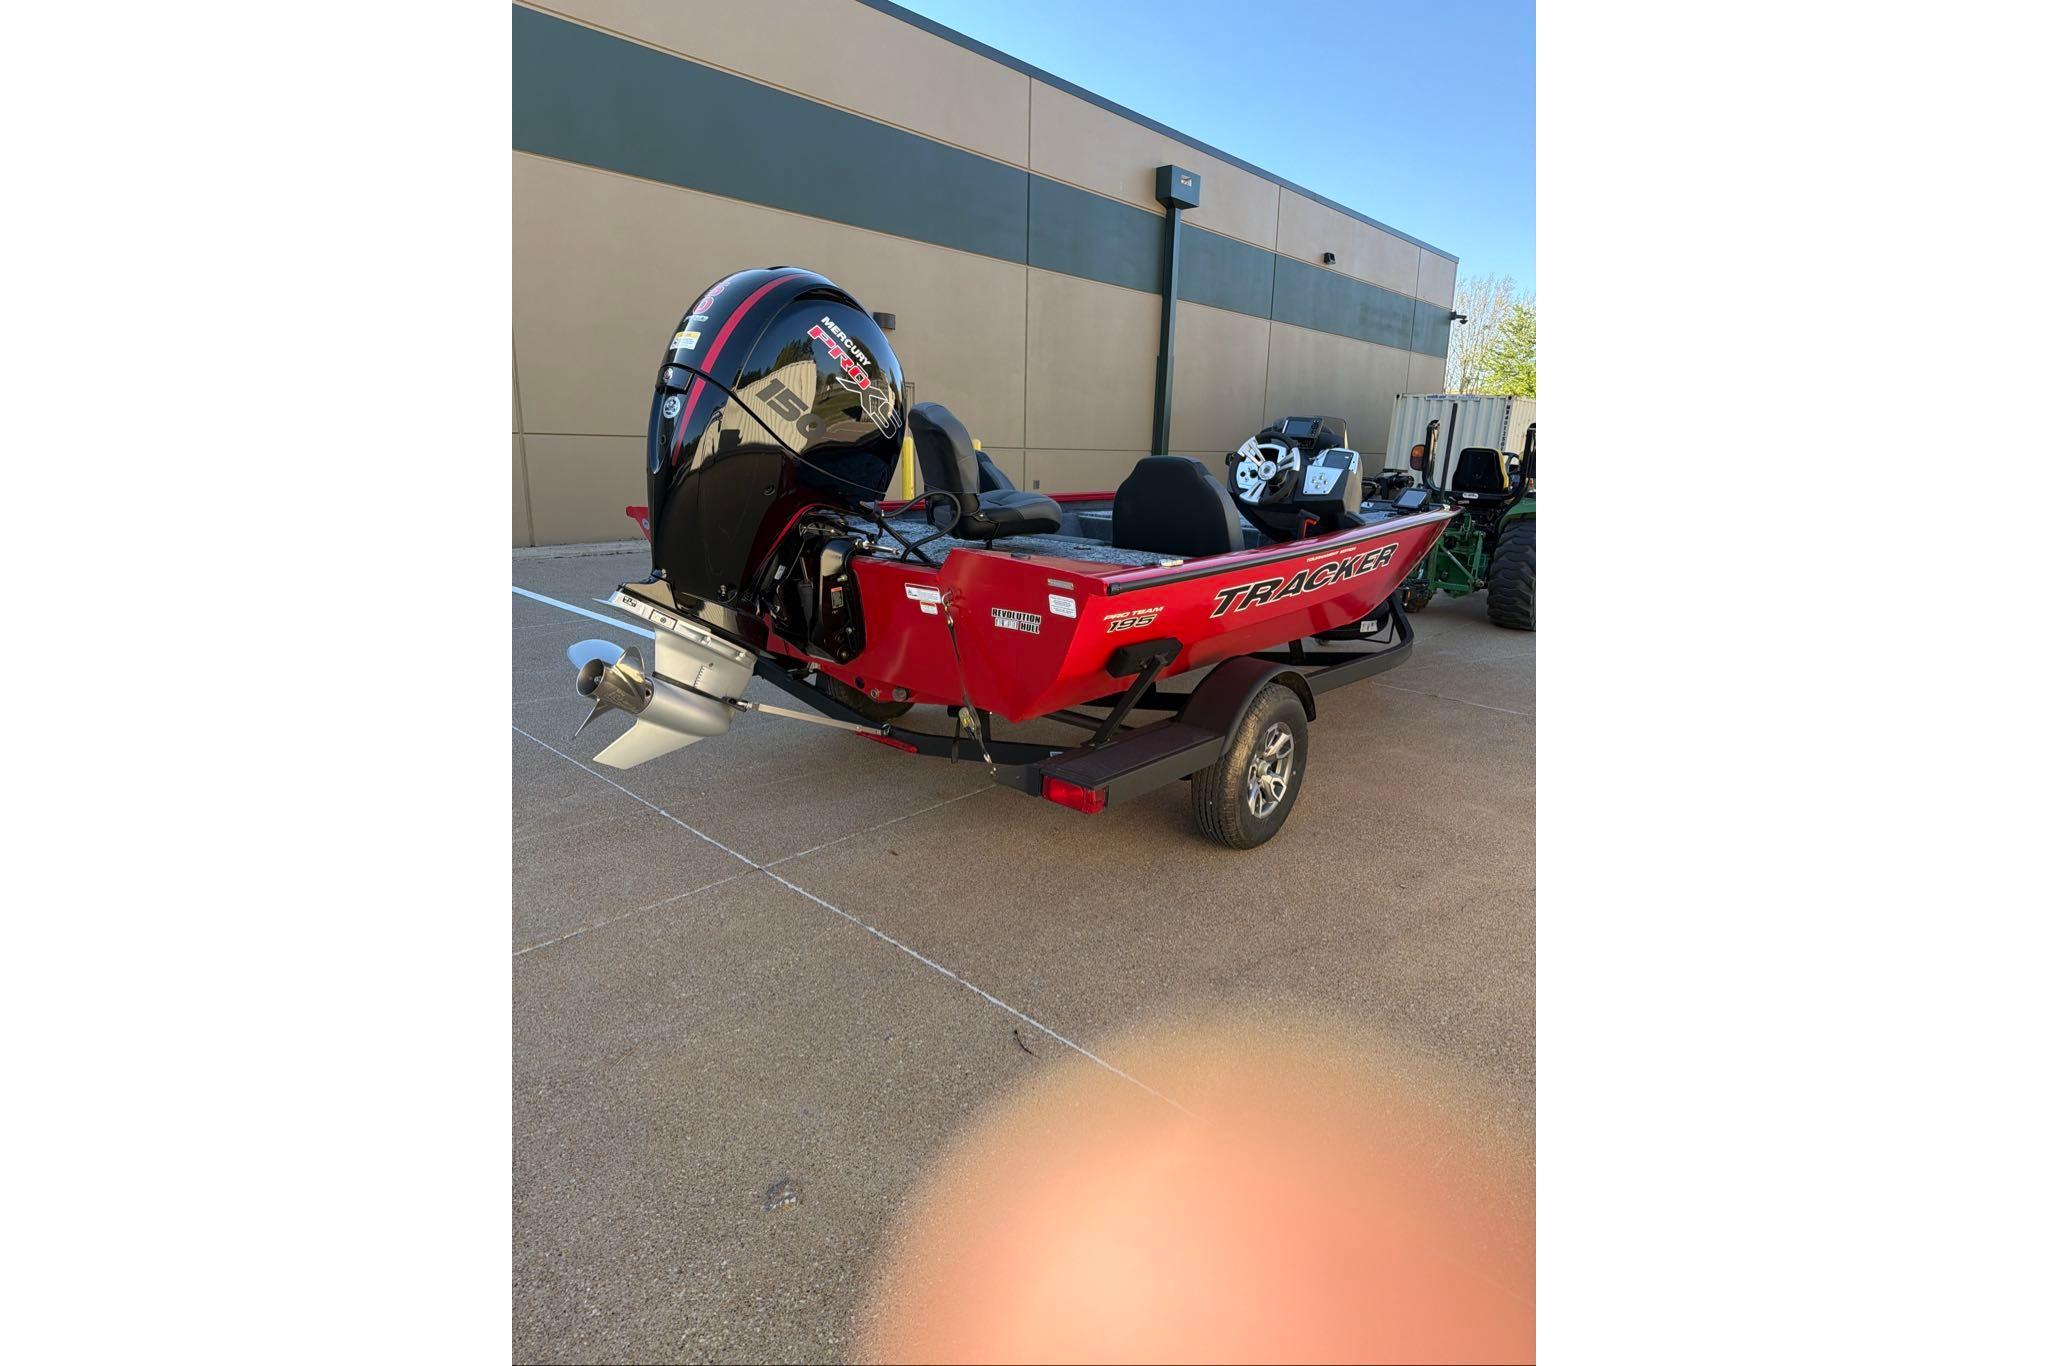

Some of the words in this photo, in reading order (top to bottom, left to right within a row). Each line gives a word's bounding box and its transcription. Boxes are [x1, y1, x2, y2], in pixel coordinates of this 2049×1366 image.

[807, 324, 871, 390] PRO
[821, 316, 871, 366] MERCURY
[755, 378, 827, 440] 150
[1210, 543, 1399, 619] TRACKER
[992, 607, 1042, 624] REVOLUTION
[1020, 620, 1040, 634] HULL
[1103, 612, 1130, 621] PRO
[1132, 606, 1164, 616] TEAM
[1106, 614, 1158, 634] 195
